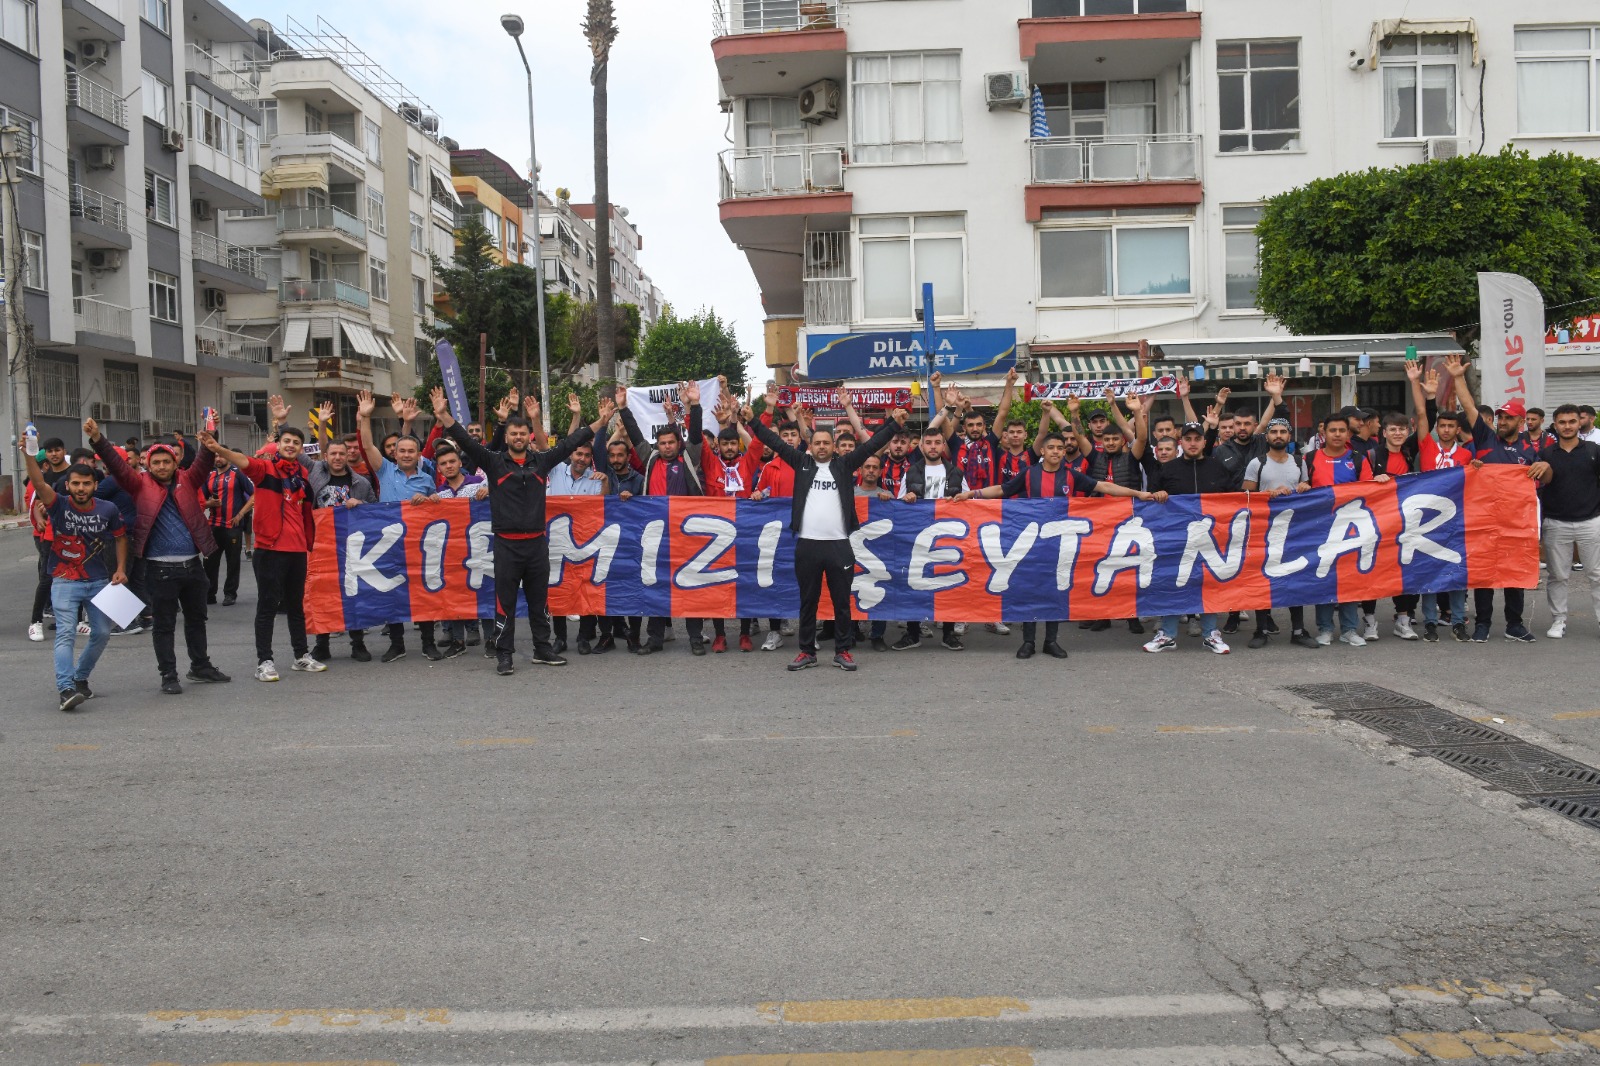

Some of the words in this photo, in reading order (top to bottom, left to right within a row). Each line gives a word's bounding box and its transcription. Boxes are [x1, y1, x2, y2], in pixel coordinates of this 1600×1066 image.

[873, 338, 953, 353] DİLAA
[795, 392, 828, 404] MERSİN
[830, 393, 858, 404] İDN
[862, 392, 893, 405] YURDU
[65, 521, 109, 533] ŞETANLA
[851, 494, 1462, 610] ŞEYTANLAR
